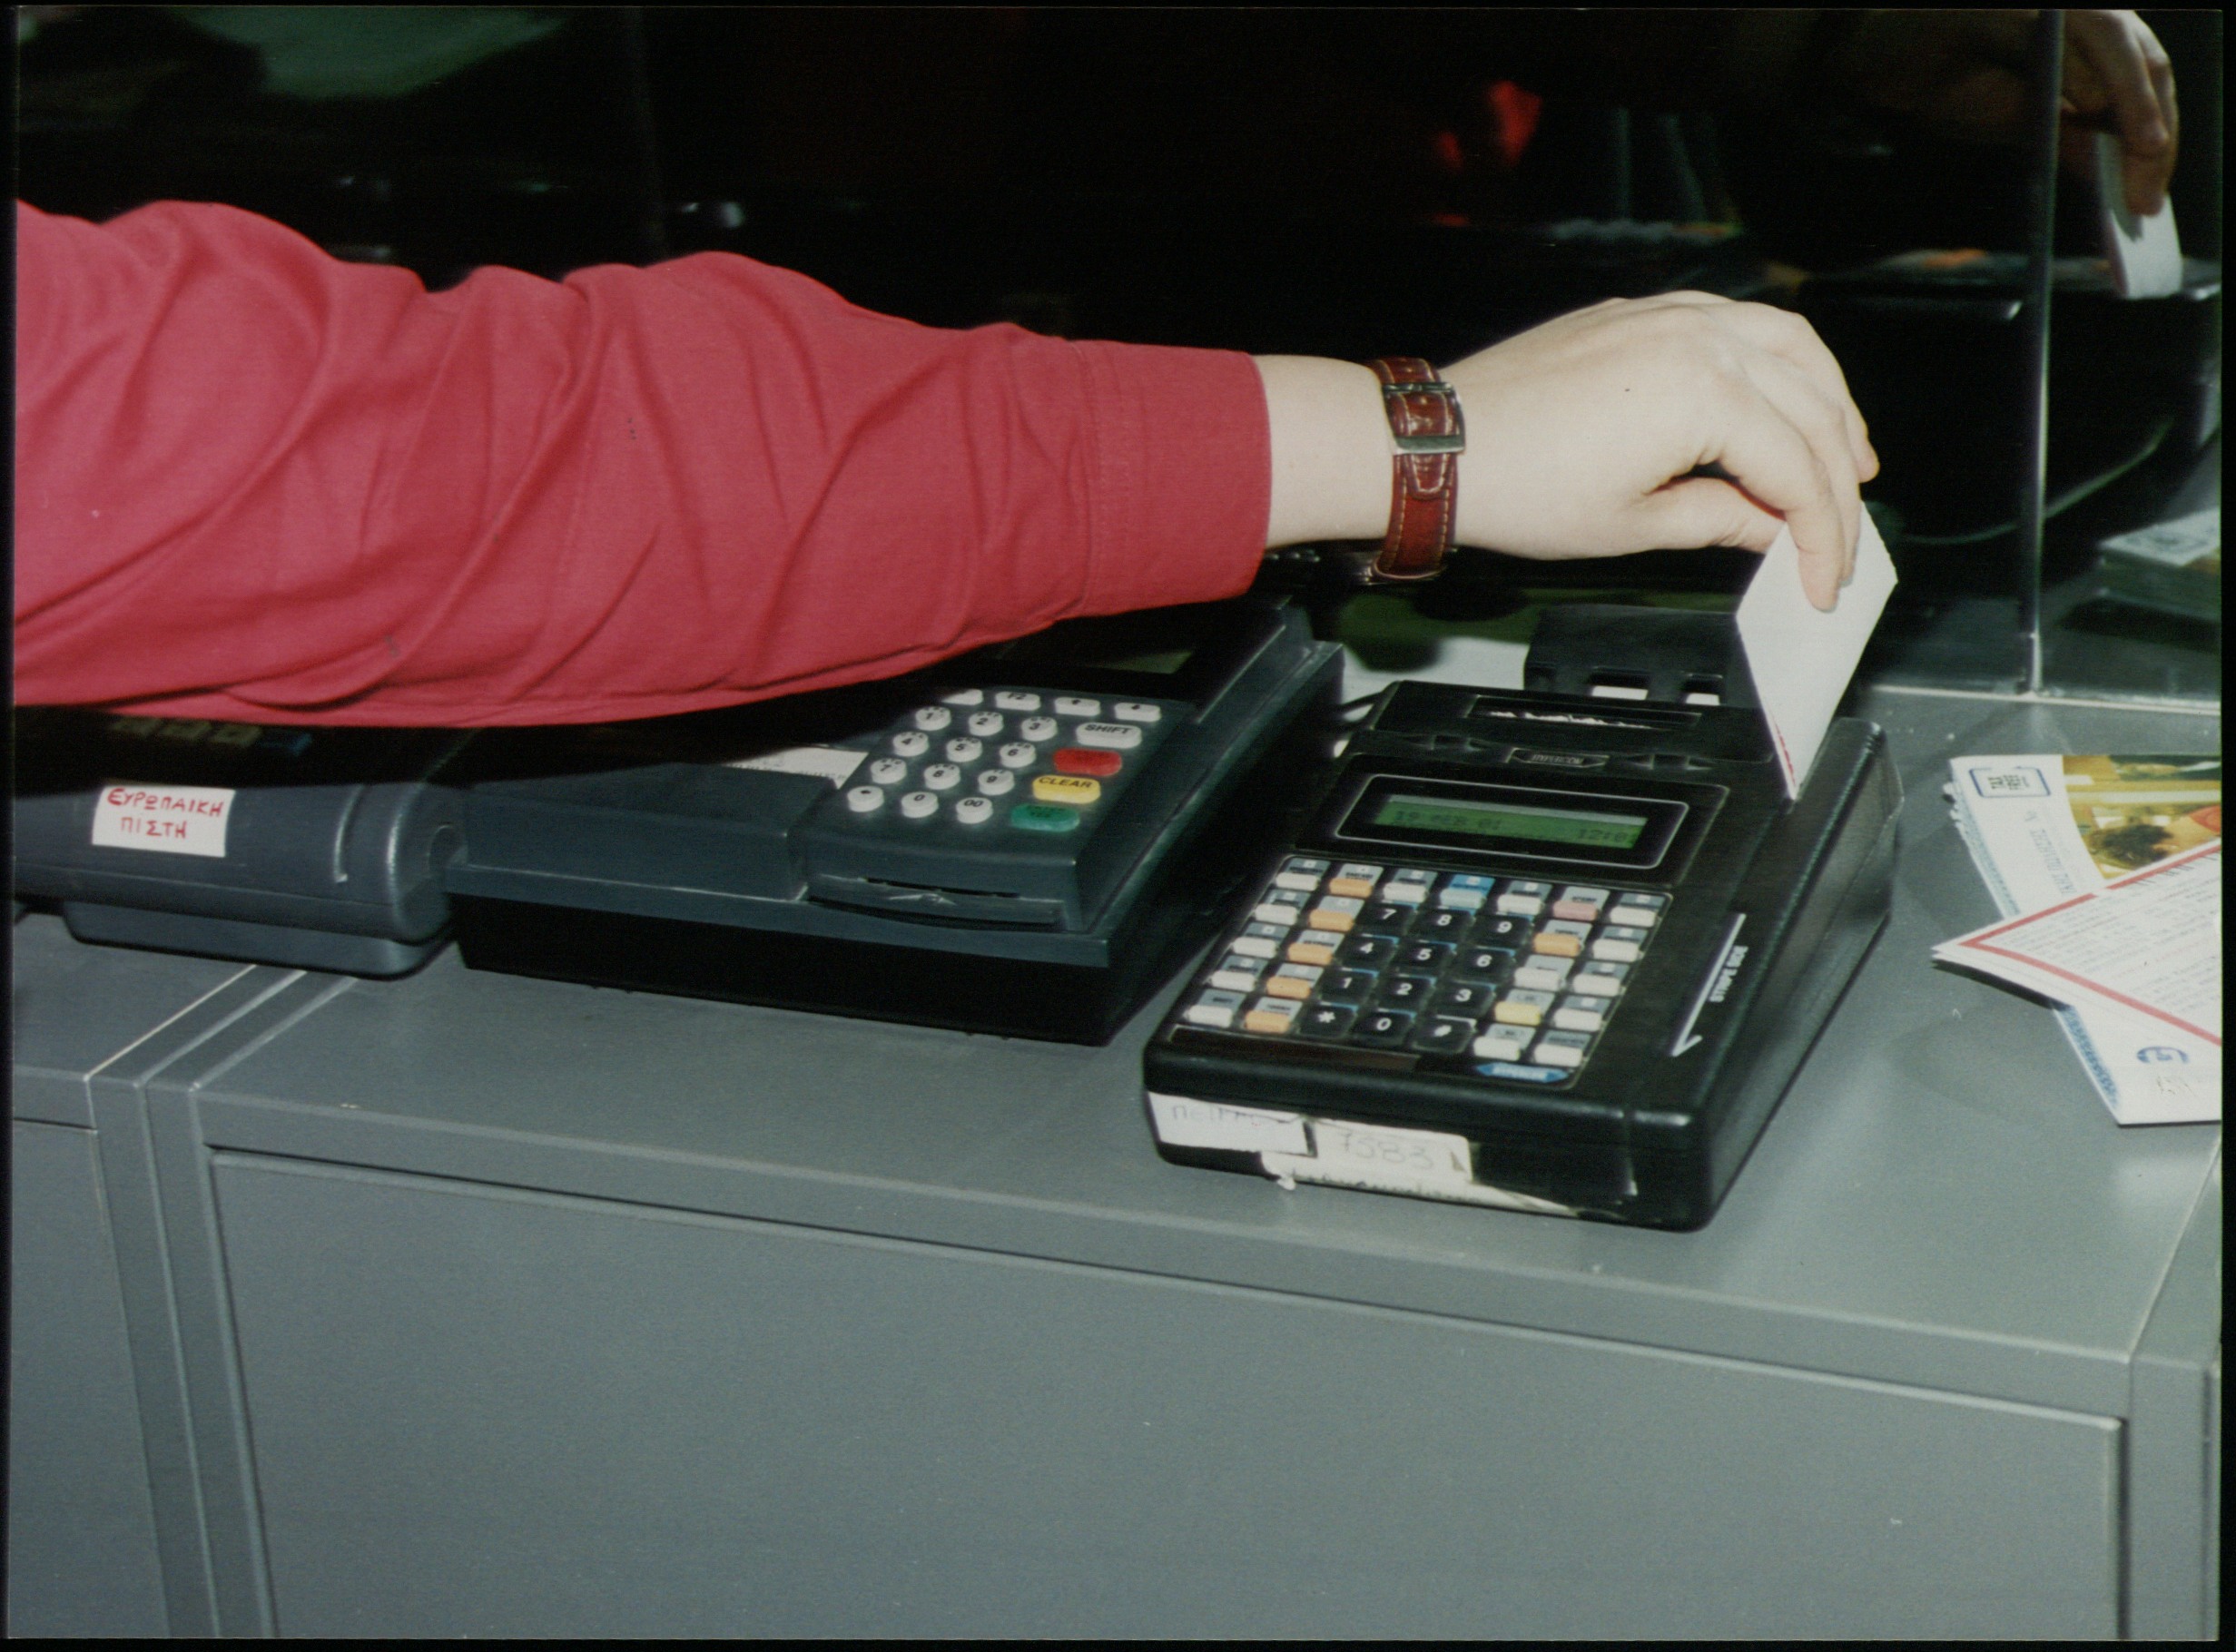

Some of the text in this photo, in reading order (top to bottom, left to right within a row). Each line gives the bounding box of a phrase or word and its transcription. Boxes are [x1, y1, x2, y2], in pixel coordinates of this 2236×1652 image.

[976, 717, 989, 725] 2
[1029, 723, 1041, 731] 3
[1085, 724, 1132, 734] SHIFT
[933, 770, 944, 778] 8
[986, 775, 998, 783] 9
[1039, 777, 1092, 789] CLEAR
[107, 787, 224, 817] ΕΥΡΩΠΑΙΚΗ
[963, 799, 984, 807] 00
[120, 816, 187, 839] ΠΙΣΤΗ
[1381, 908, 1397, 920] 7
[1436, 914, 1452, 927] 8
[1496, 920, 1512, 934] 9
[1360, 942, 1374, 954] 4
[1415, 949, 1432, 961] 5
[1476, 954, 1492, 968] 6
[1342, 977, 1353, 989] 1
[1395, 983, 1413, 996] 2
[1455, 988, 1473, 1002] 3
[1376, 1018, 1392, 1031] 0
[1341, 1133, 1433, 1169] 7583
